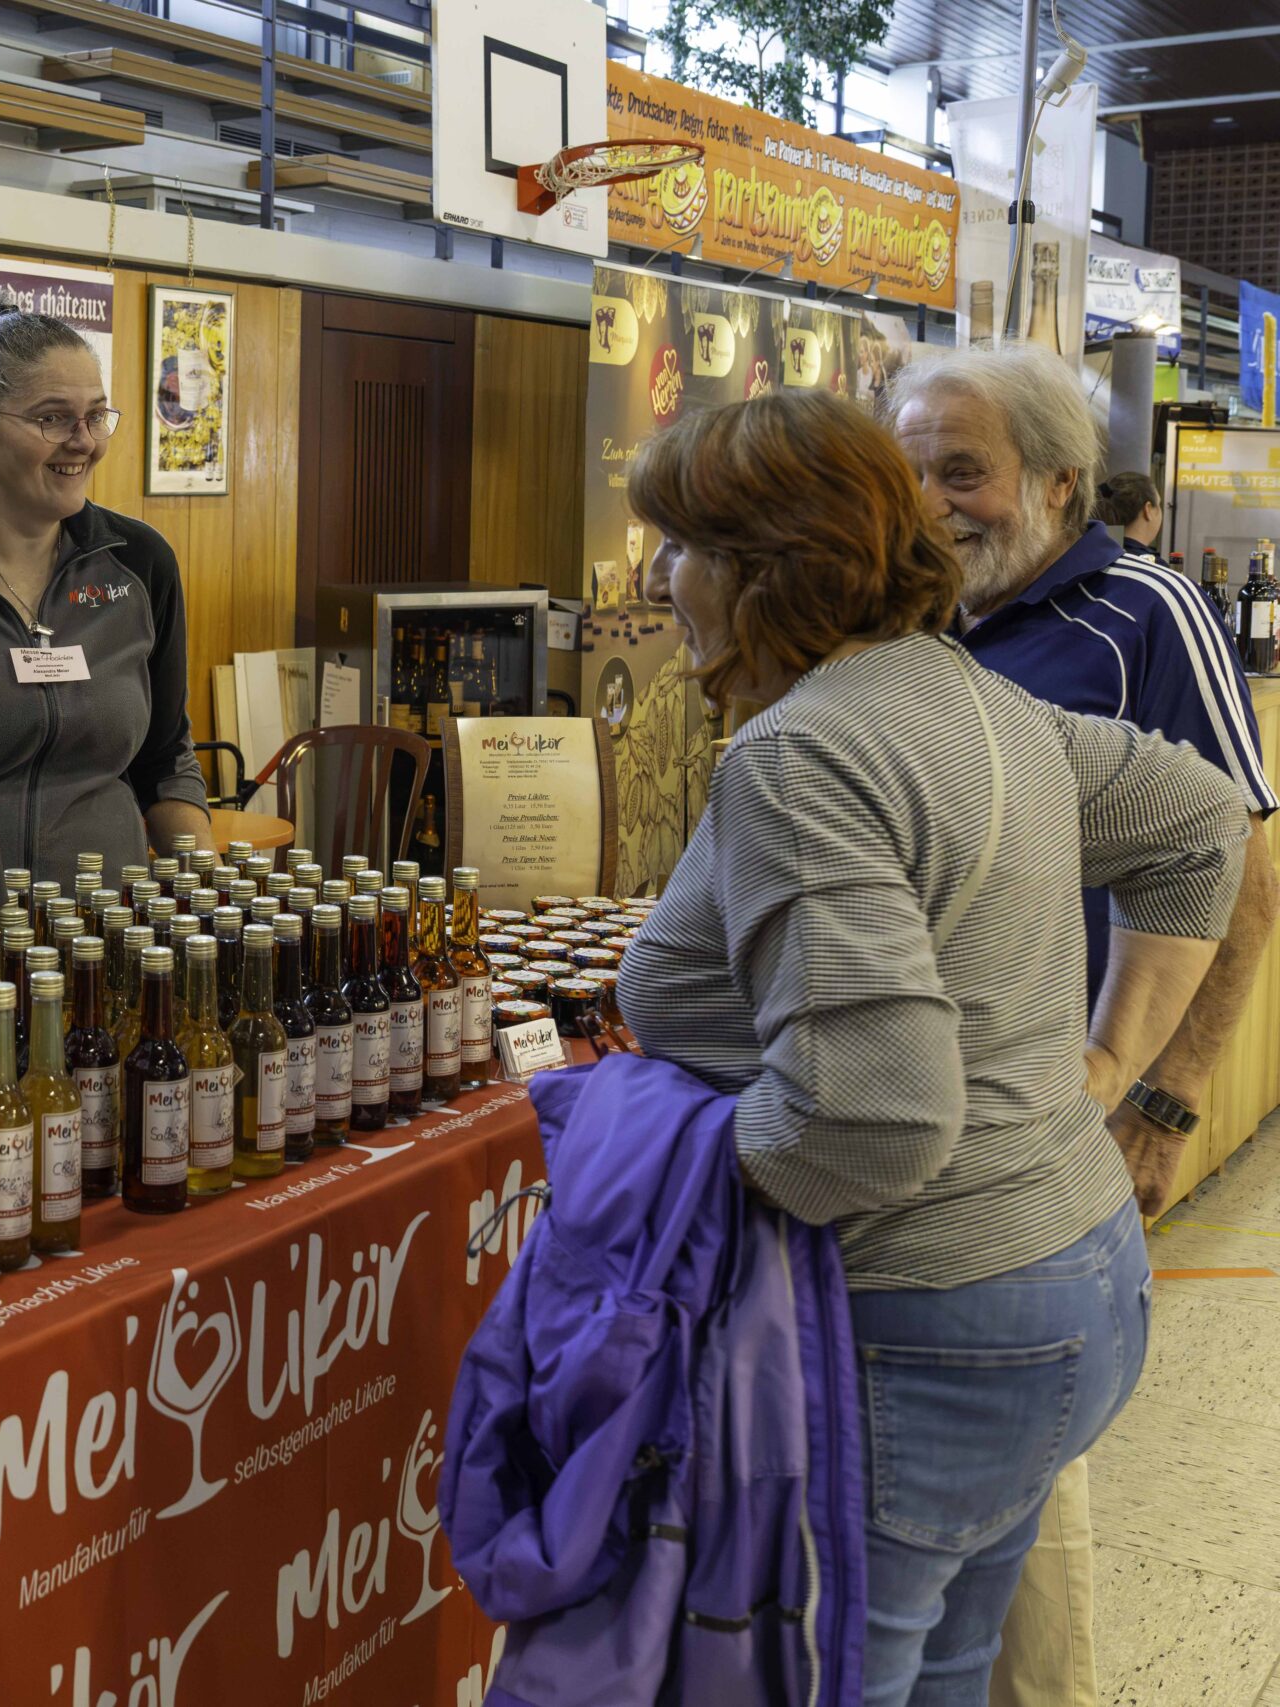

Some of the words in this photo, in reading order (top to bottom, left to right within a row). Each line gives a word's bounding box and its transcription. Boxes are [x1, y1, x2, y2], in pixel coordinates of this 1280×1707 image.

[680, 109, 704, 140] Design,
[707, 117, 730, 145] Fotos,
[765, 134, 778, 158] Der
[443, 212, 469, 225] ERHARD
[39, 284, 107, 322] châteaux
[601, 438, 622, 461] Zum
[69, 586, 86, 603] Mei
[482, 734, 508, 751] Mei
[526, 733, 565, 753] Likör
[507, 793, 527, 802] Preise
[499, 814, 520, 823] Preise
[466, 983, 485, 999] Mei
[433, 995, 452, 1011] Mei
[355, 1020, 377, 1036] Mei
[320, 1032, 340, 1049] Mei
[80, 1076, 103, 1094] Mei
[195, 1074, 219, 1094] Mei
[149, 1089, 173, 1107] Mei
[48, 1119, 72, 1140] Mei
[247, 1210, 431, 1421] Likör
[20, 1527, 128, 1610] Manufaktur
[128, 1506, 151, 1549] für
[233, 1397, 352, 1485] selbstgemachte
[354, 1373, 397, 1415] Liköre
[276, 1457, 391, 1660] Mei
[303, 1632, 378, 1707] Manufaktur
[378, 1615, 398, 1646] für
